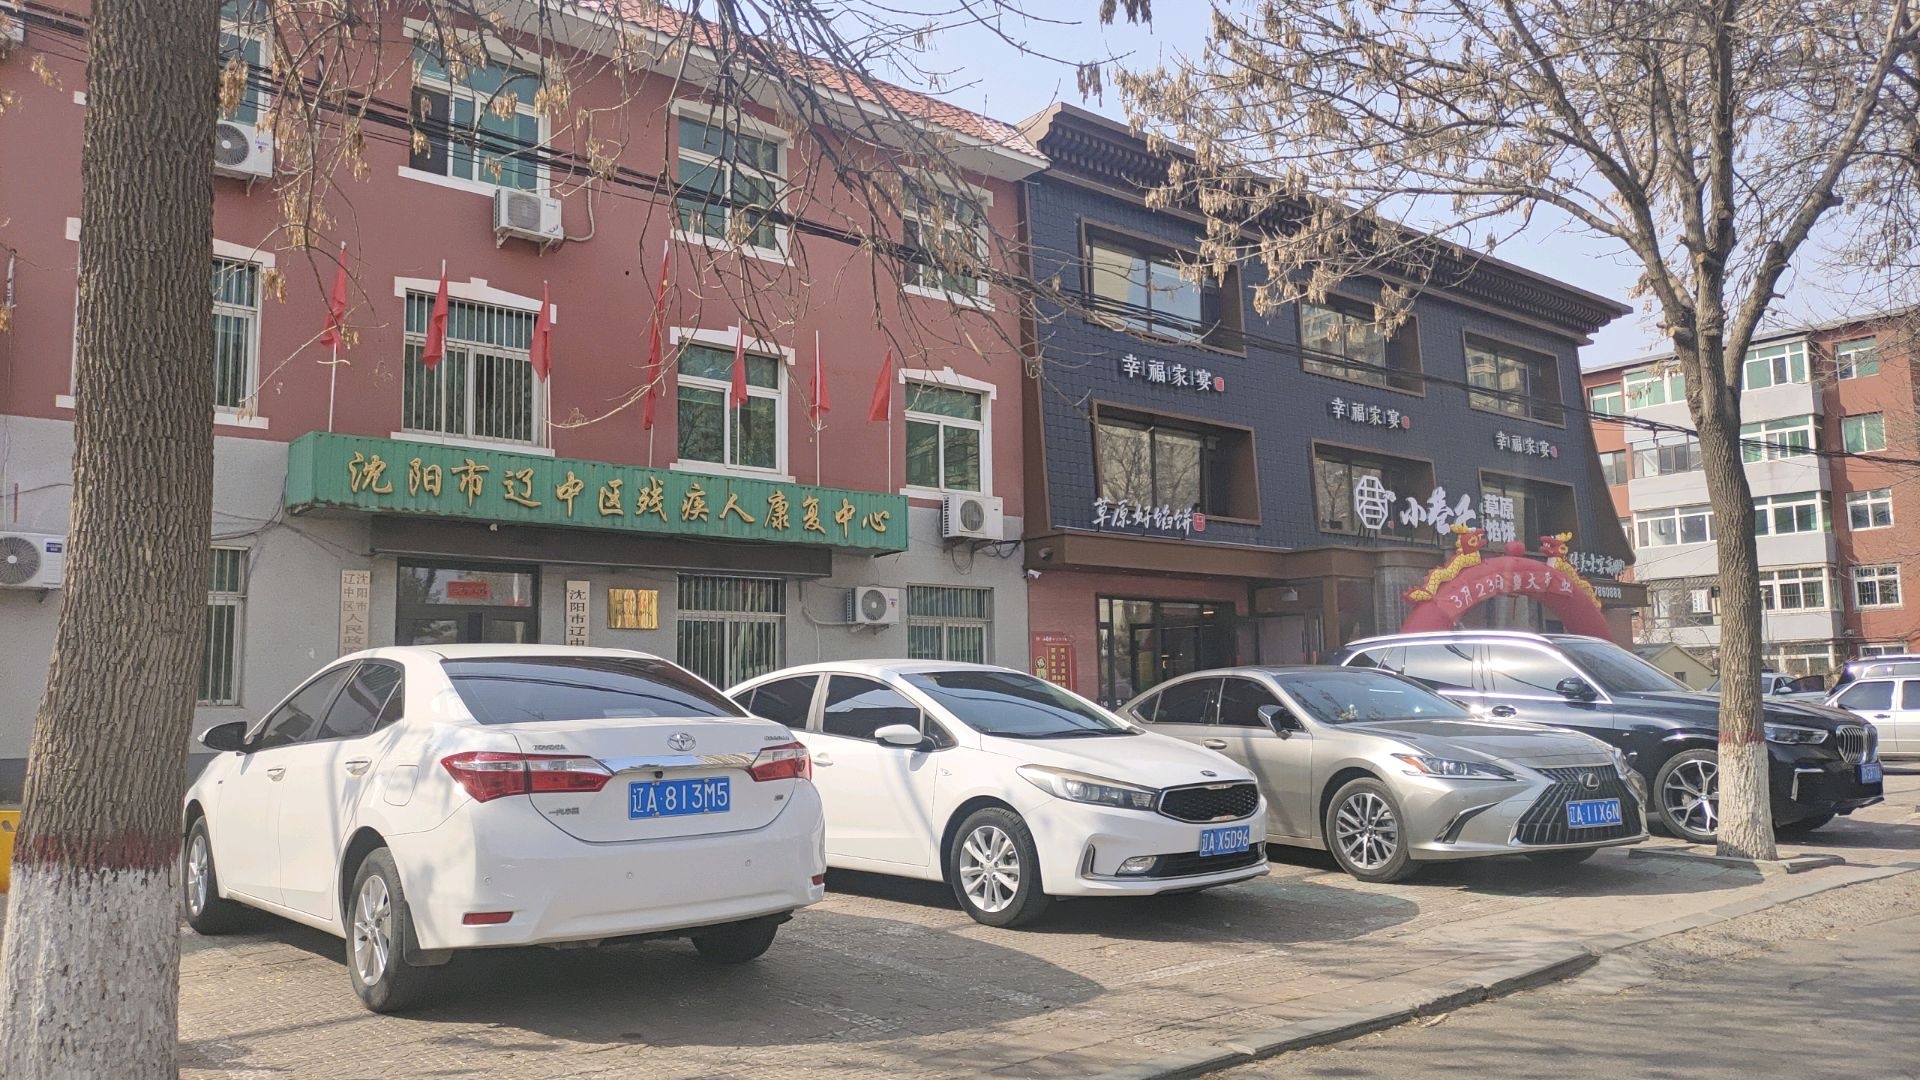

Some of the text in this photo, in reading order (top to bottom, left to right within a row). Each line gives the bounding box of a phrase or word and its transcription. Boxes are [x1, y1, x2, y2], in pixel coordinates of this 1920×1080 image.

[1122, 353, 1212, 391] 幸福家宴
[1331, 396, 1401, 429] 幸福家宴
[1496, 430, 1550, 458] 幸福家宴
[348, 451, 890, 539] 沈阳市辽中区残疾人康复中心
[1092, 496, 1194, 536] 草原好馅饼
